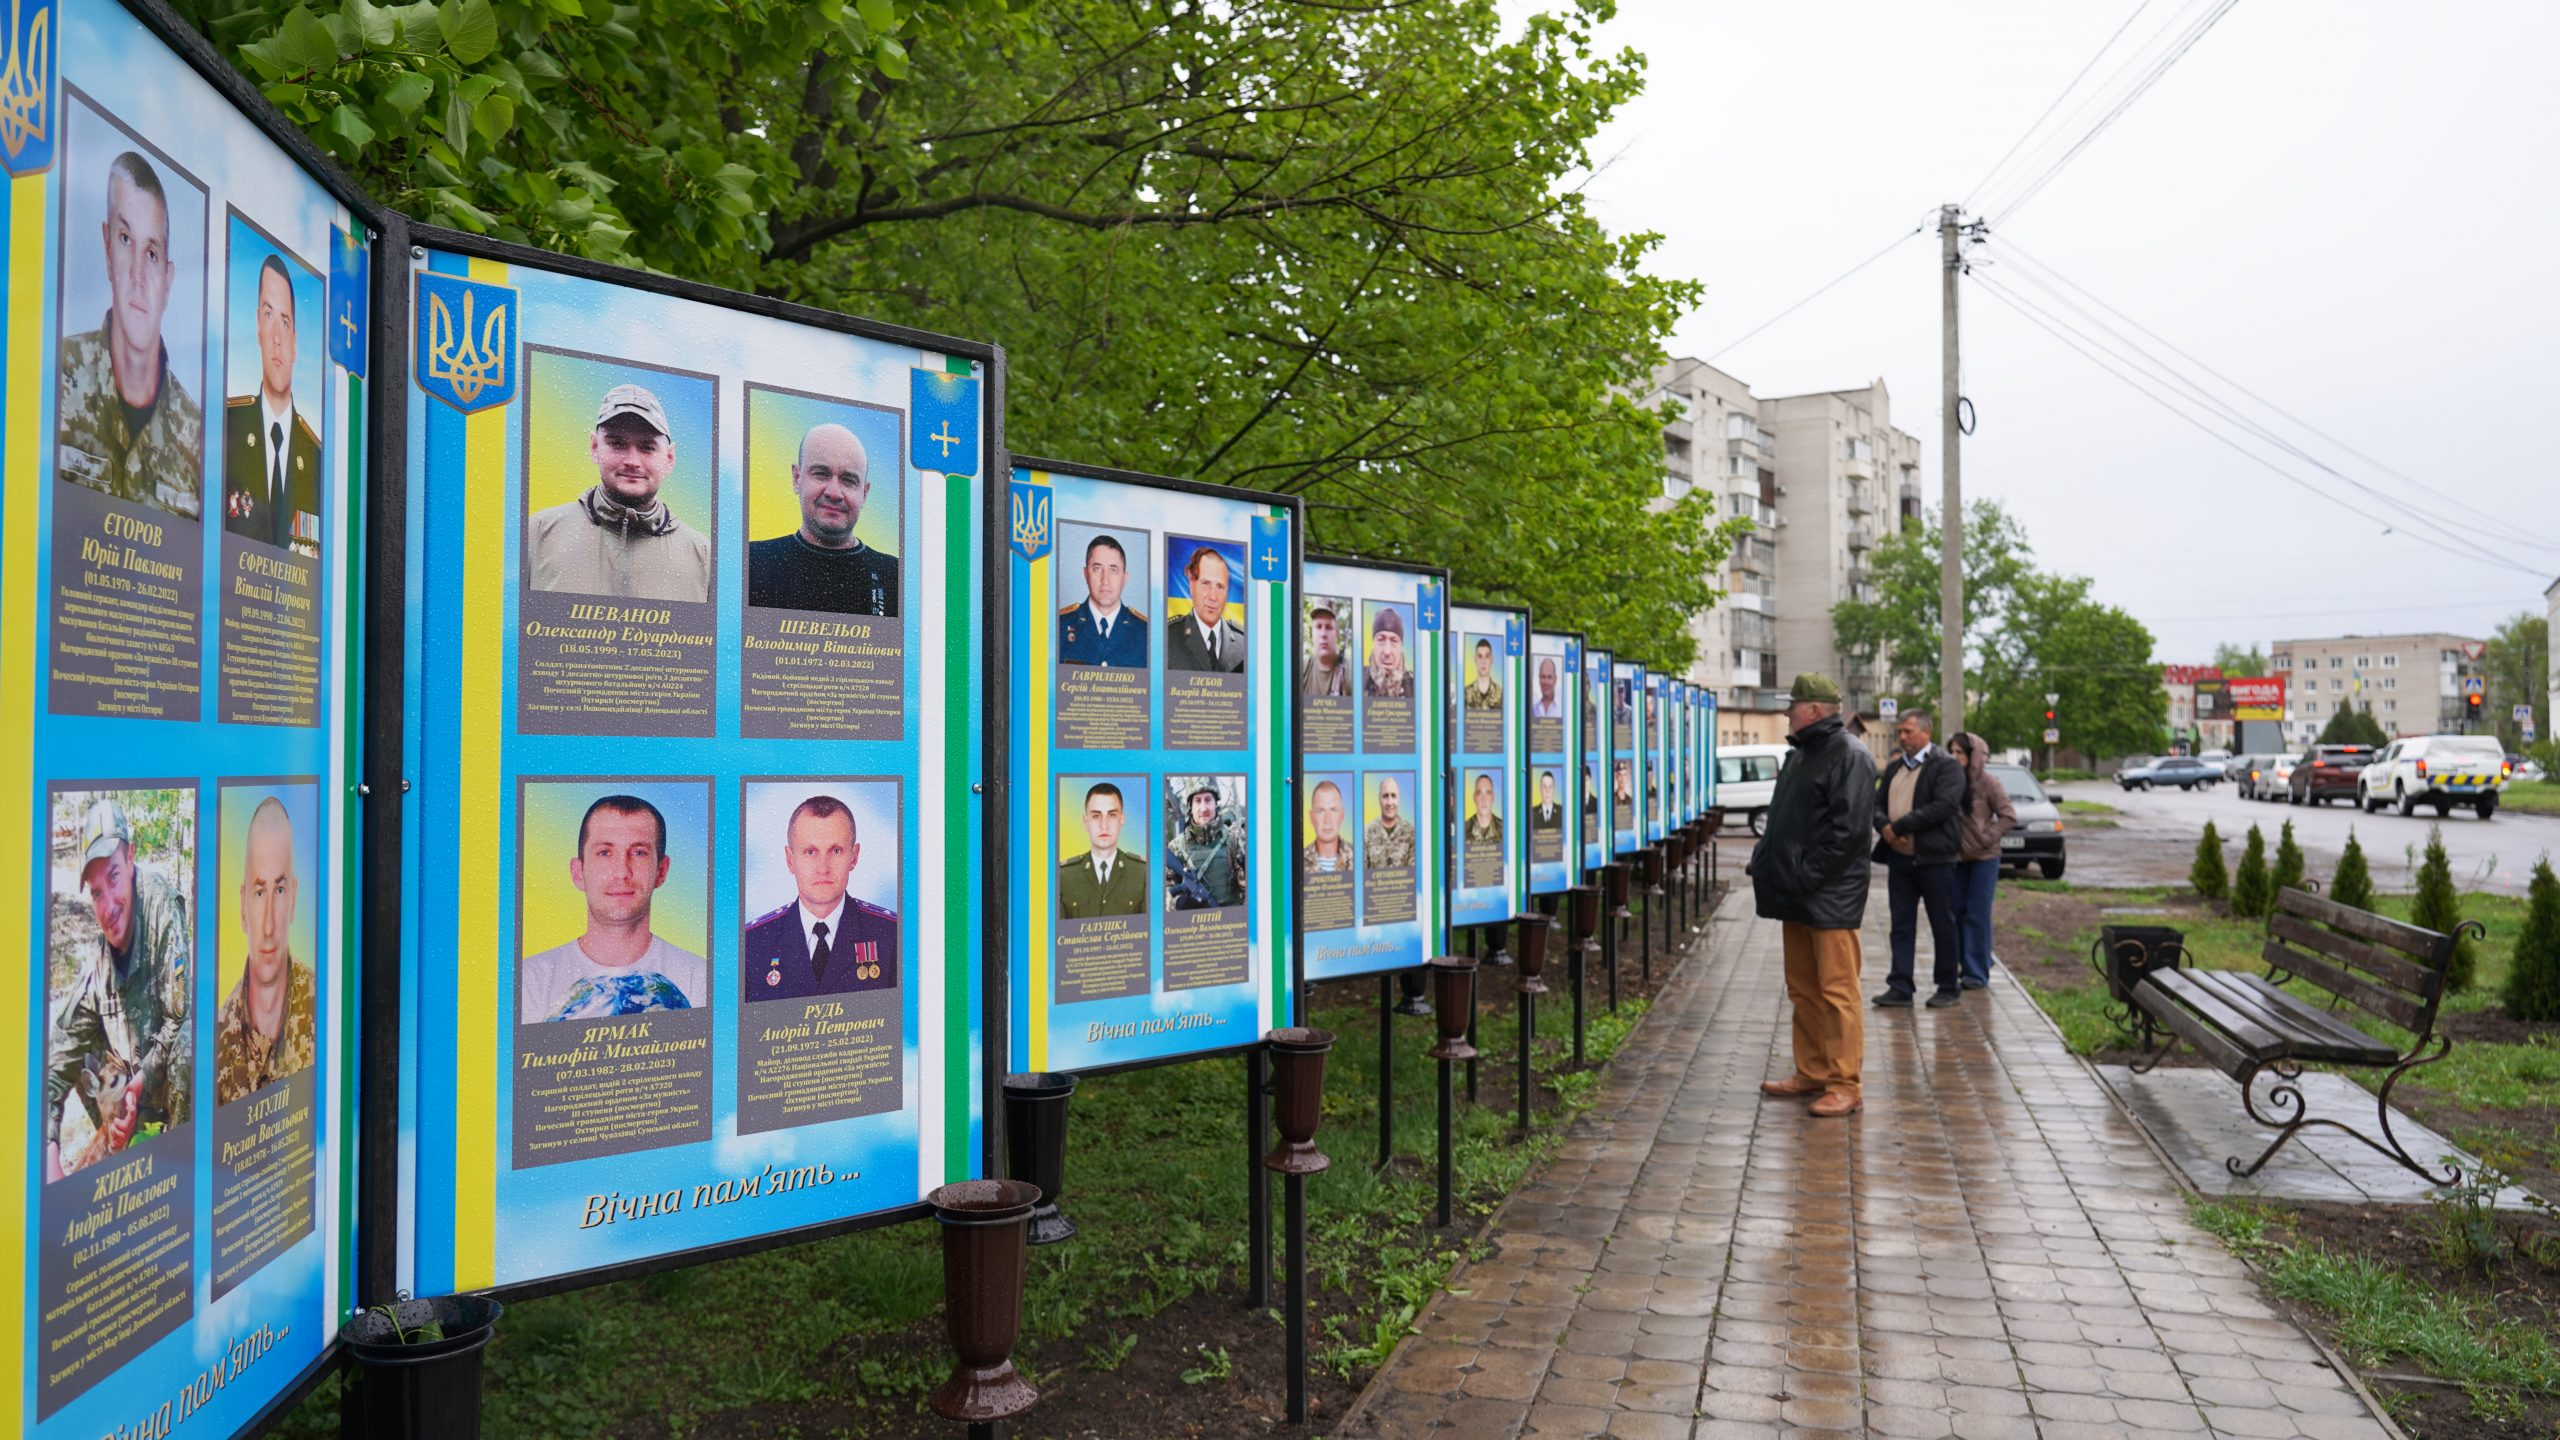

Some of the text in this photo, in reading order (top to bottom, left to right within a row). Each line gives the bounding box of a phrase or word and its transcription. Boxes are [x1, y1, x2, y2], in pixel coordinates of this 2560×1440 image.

[104, 512, 162, 546] ЄГОРОВ
[81, 537, 183, 581] Юрій Павлович
[84, 571, 131, 591] (01.05.1970
[138, 583, 178, 603] 26.02.2022)
[571, 605, 670, 623] ШЕВАНОВ
[526, 621, 713, 646] Олександр Едуардович
[780, 620, 870, 637] ШЕВЕЛЬОВ
[560, 644, 617, 654] (18.05.1999
[628, 648, 681, 659] 17.05.2023)
[745, 636, 901, 656] Володимир Віталійович
[776, 657, 874, 670] (01.01.1972 02.03.2022)
[805, 1003, 843, 1018] РУДЬ
[583, 1023, 651, 1042] ЯРМАК
[760, 1018, 885, 1041] Андрій Петрович
[1086, 1021, 1137, 1043] Вічна
[522, 1039, 706, 1068] Тимофій Михайлович
[772, 1041, 819, 1056] (21.09.1972
[828, 1035, 874, 1047] 25.02.2022)
[621, 1059, 675, 1072] 28.02.2023)
[247, 1085, 290, 1125] ЗАТУЛІЙ
[222, 1101, 309, 1165] Руслан Васильович
[94, 1154, 152, 1201] ЖИЖКА
[580, 1189, 683, 1229] Вічна
[691, 1163, 835, 1208] пам'ять
[62, 1175, 177, 1247] Андрій Павлович
[73, 1232, 120, 1269] (02.11.1980
